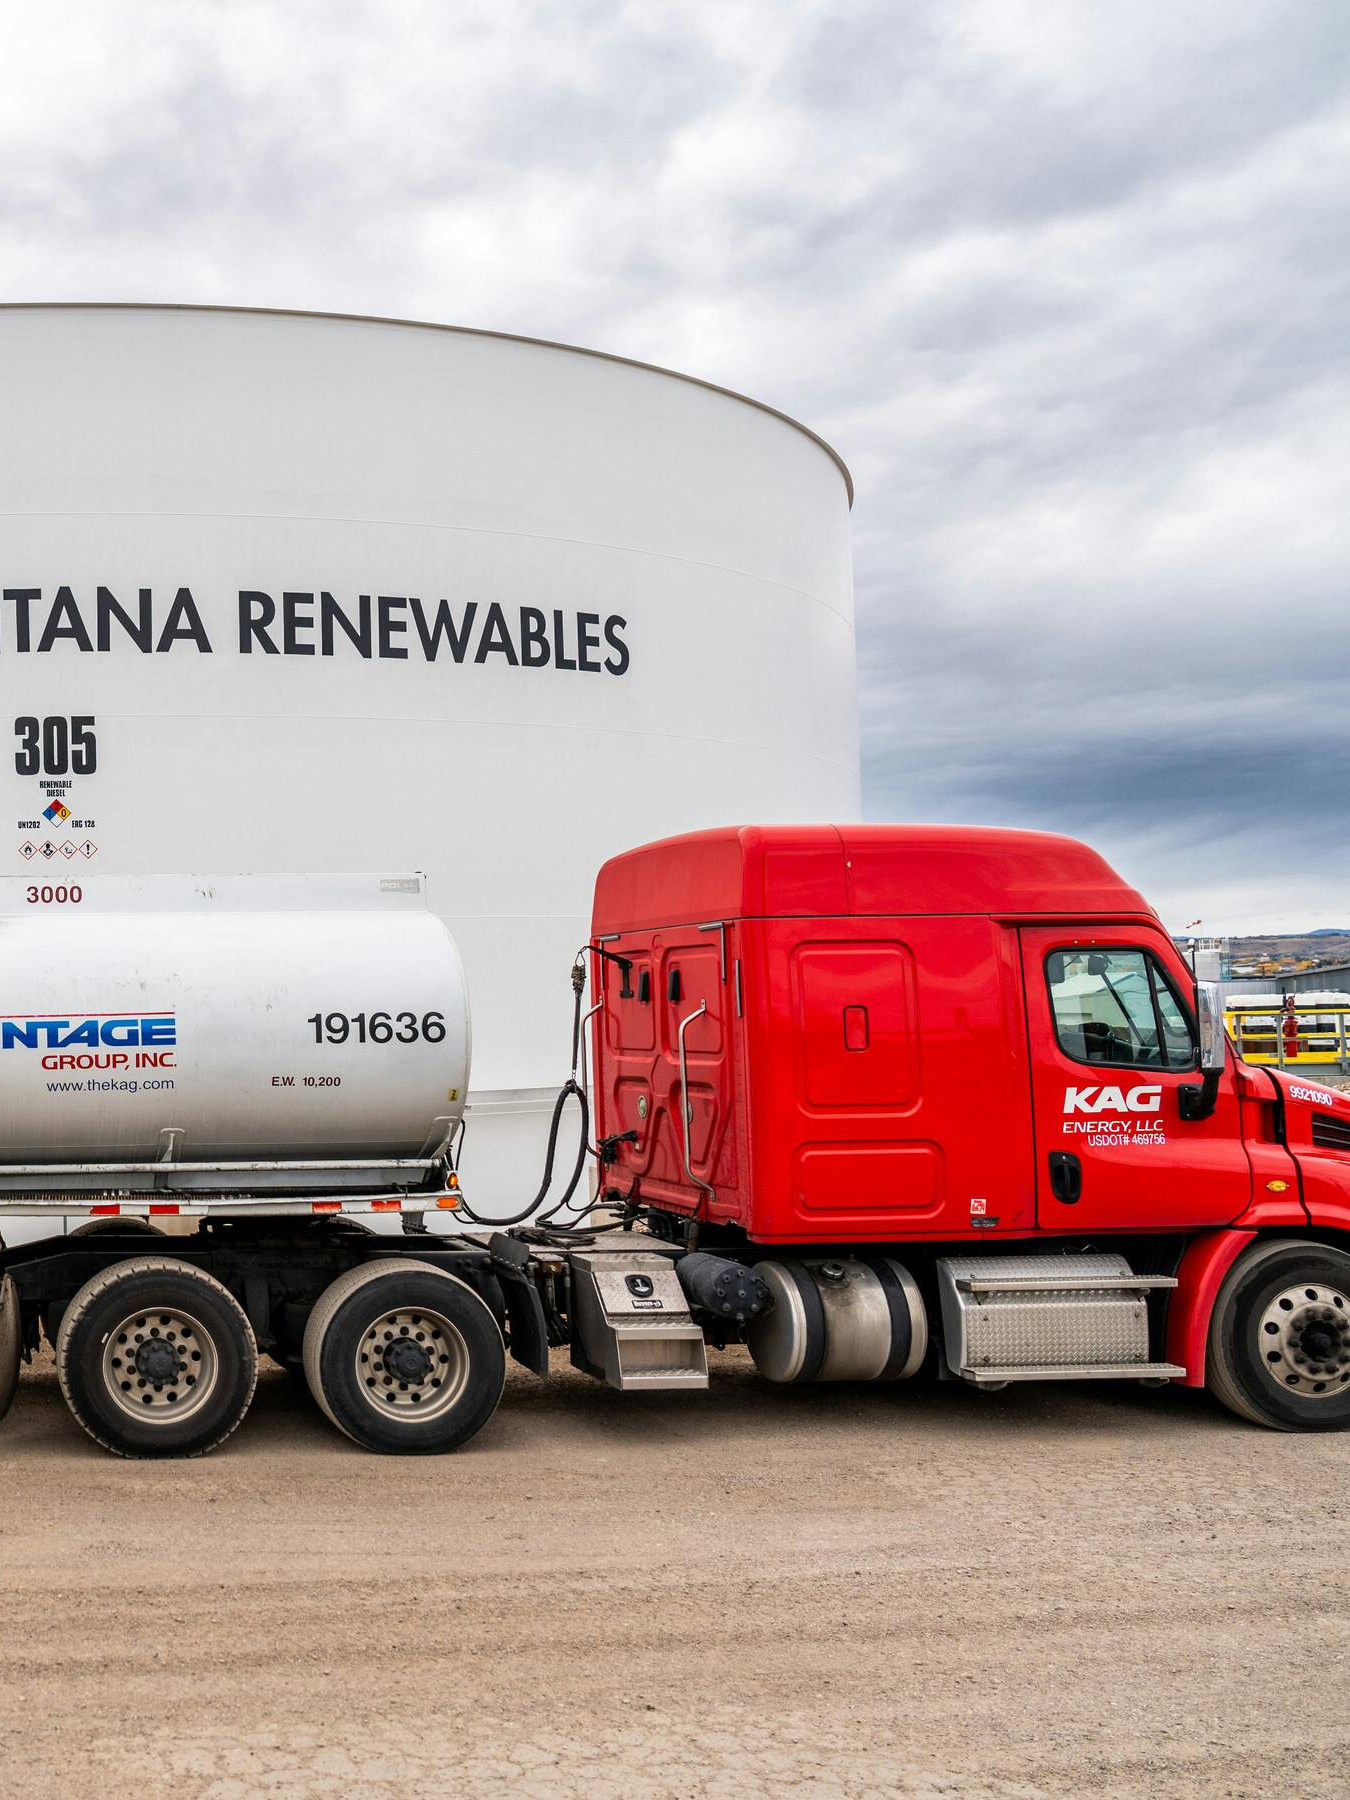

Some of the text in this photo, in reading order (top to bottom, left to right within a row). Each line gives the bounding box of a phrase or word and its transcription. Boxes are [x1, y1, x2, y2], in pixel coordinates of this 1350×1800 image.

[238, 590, 631, 676] RENEWABLES
[15, 716, 97, 776] 305
[39, 780, 72, 789] RENEWABLE
[46, 789, 66, 798] DIESEL
[61, 808, 67, 818] 0
[17, 820, 41, 829] UN1202
[71, 820, 96, 829] ERG 128
[26, 885, 83, 904] 3000
[307, 1012, 446, 1044] 191636
[41, 1052, 177, 1071] GROUP, INC.
[46, 1079, 175, 1093] www.thekag.com
[271, 1076, 341, 1088] E.W. 10,200
[1063, 1085, 1163, 1114] KAG
[1289, 1085, 1333, 1106] 9921090
[1062, 1119, 1164, 1134] ENERGY, LLC
[1087, 1133, 1166, 1146] USDOT# 469756
